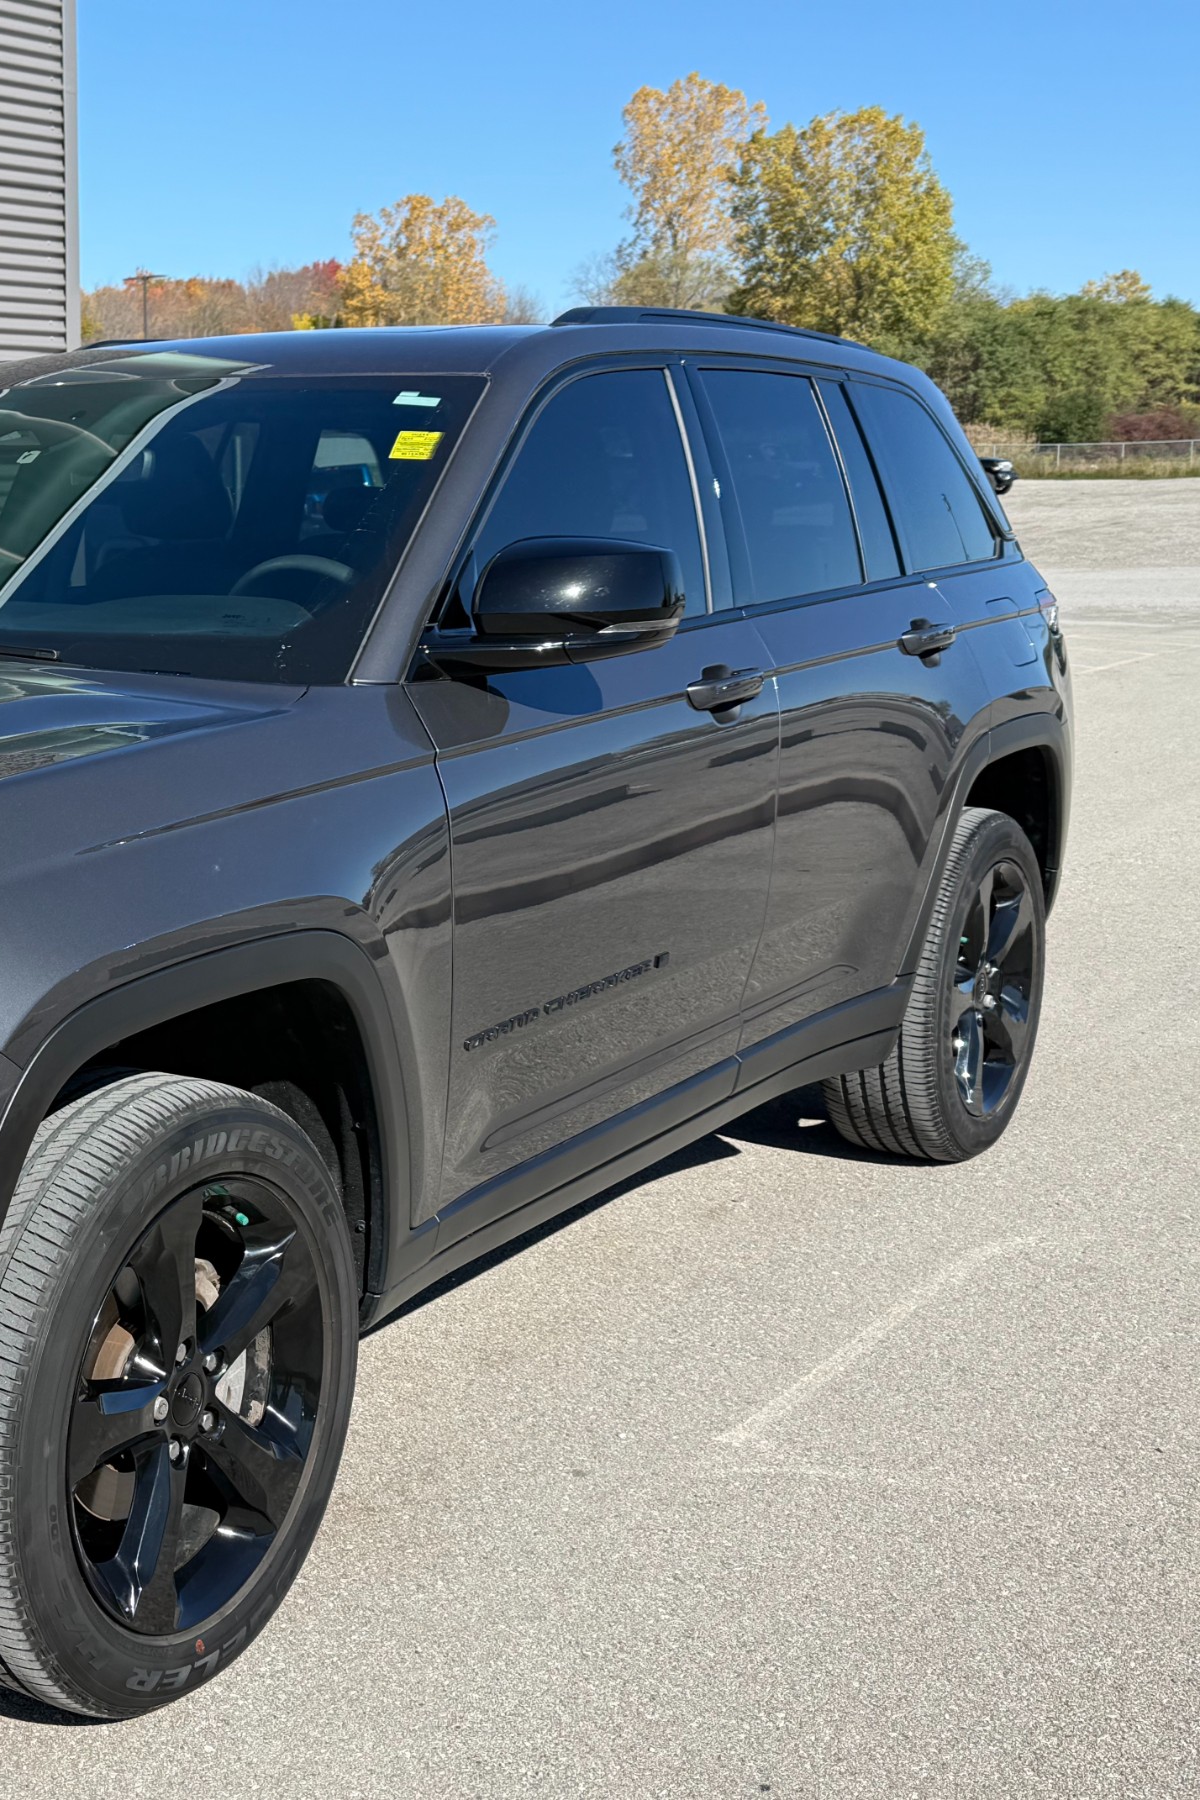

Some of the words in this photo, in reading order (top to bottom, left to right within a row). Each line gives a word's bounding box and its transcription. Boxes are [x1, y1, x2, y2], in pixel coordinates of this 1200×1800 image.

[463, 1007, 541, 1052] GRAND
[543, 959, 653, 1015] CHEROKEE
[139, 1128, 341, 1228] BRIDGESTONE
